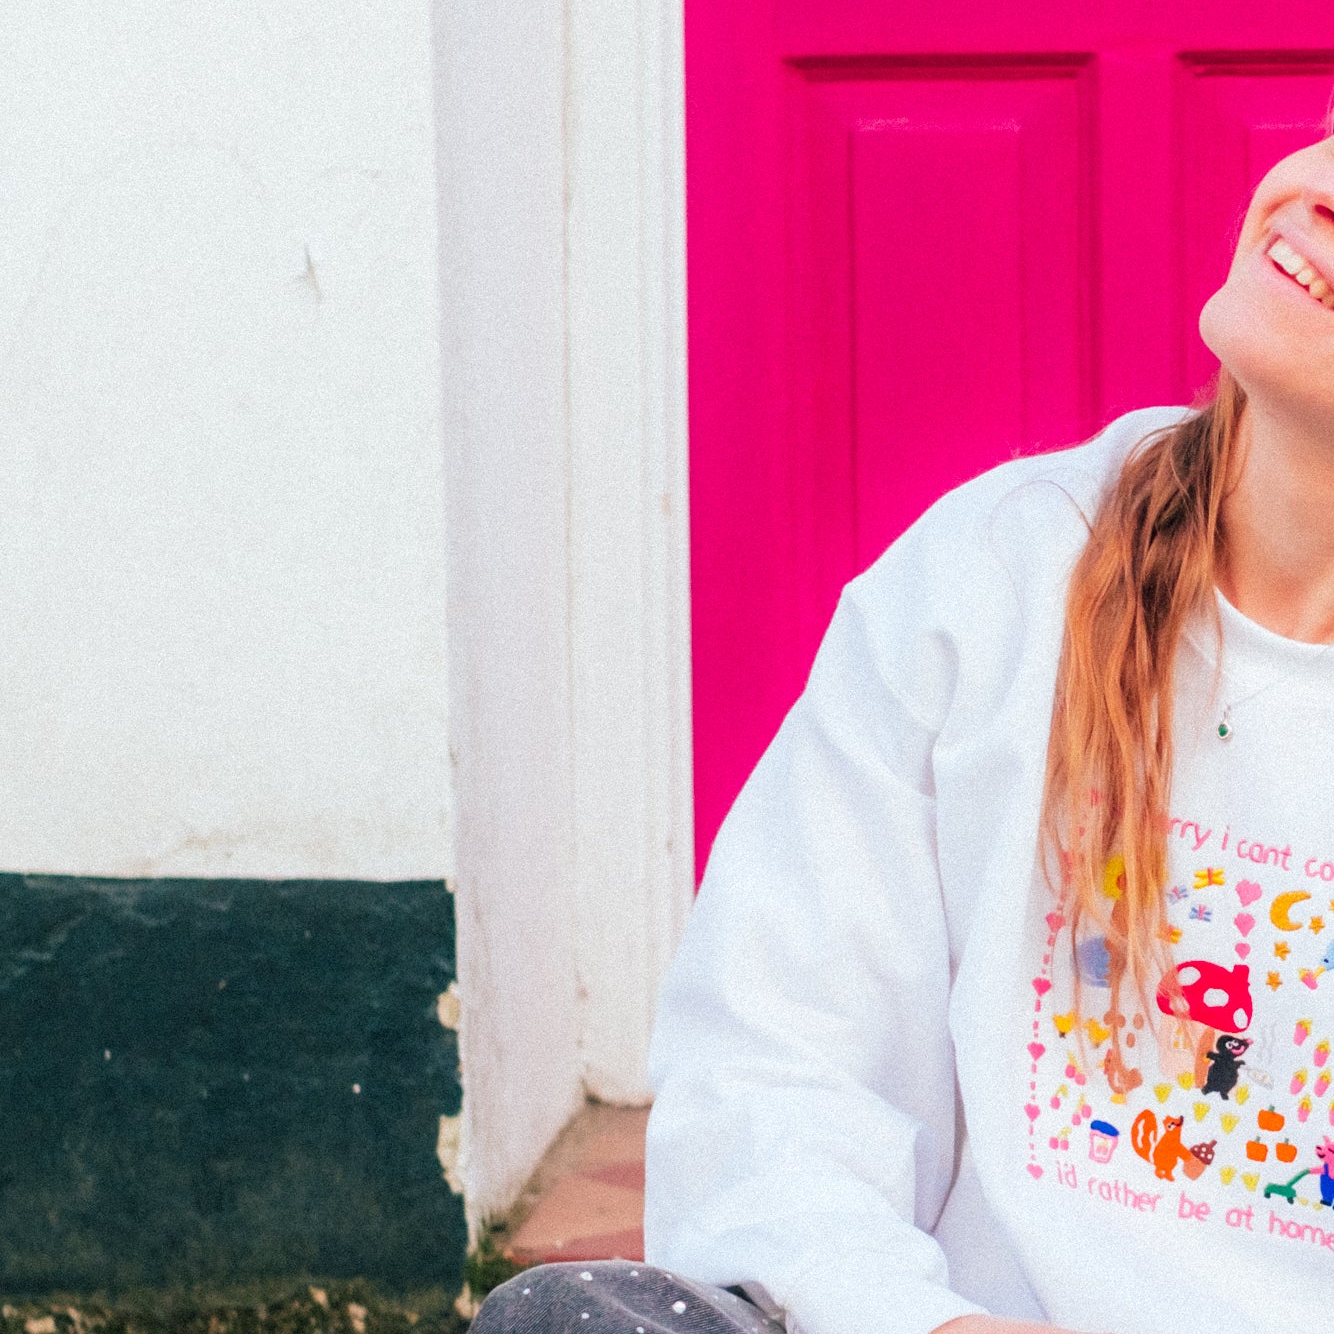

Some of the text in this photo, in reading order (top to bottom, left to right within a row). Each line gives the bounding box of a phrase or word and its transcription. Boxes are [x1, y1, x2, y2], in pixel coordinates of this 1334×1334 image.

[1160, 817, 1212, 851] rry
[1221, 825, 1230, 851] i
[1236, 838, 1292, 871] cant
[1087, 1177, 1161, 1212] rather
[1178, 1190, 1211, 1222] be
[1225, 1203, 1255, 1232] at
